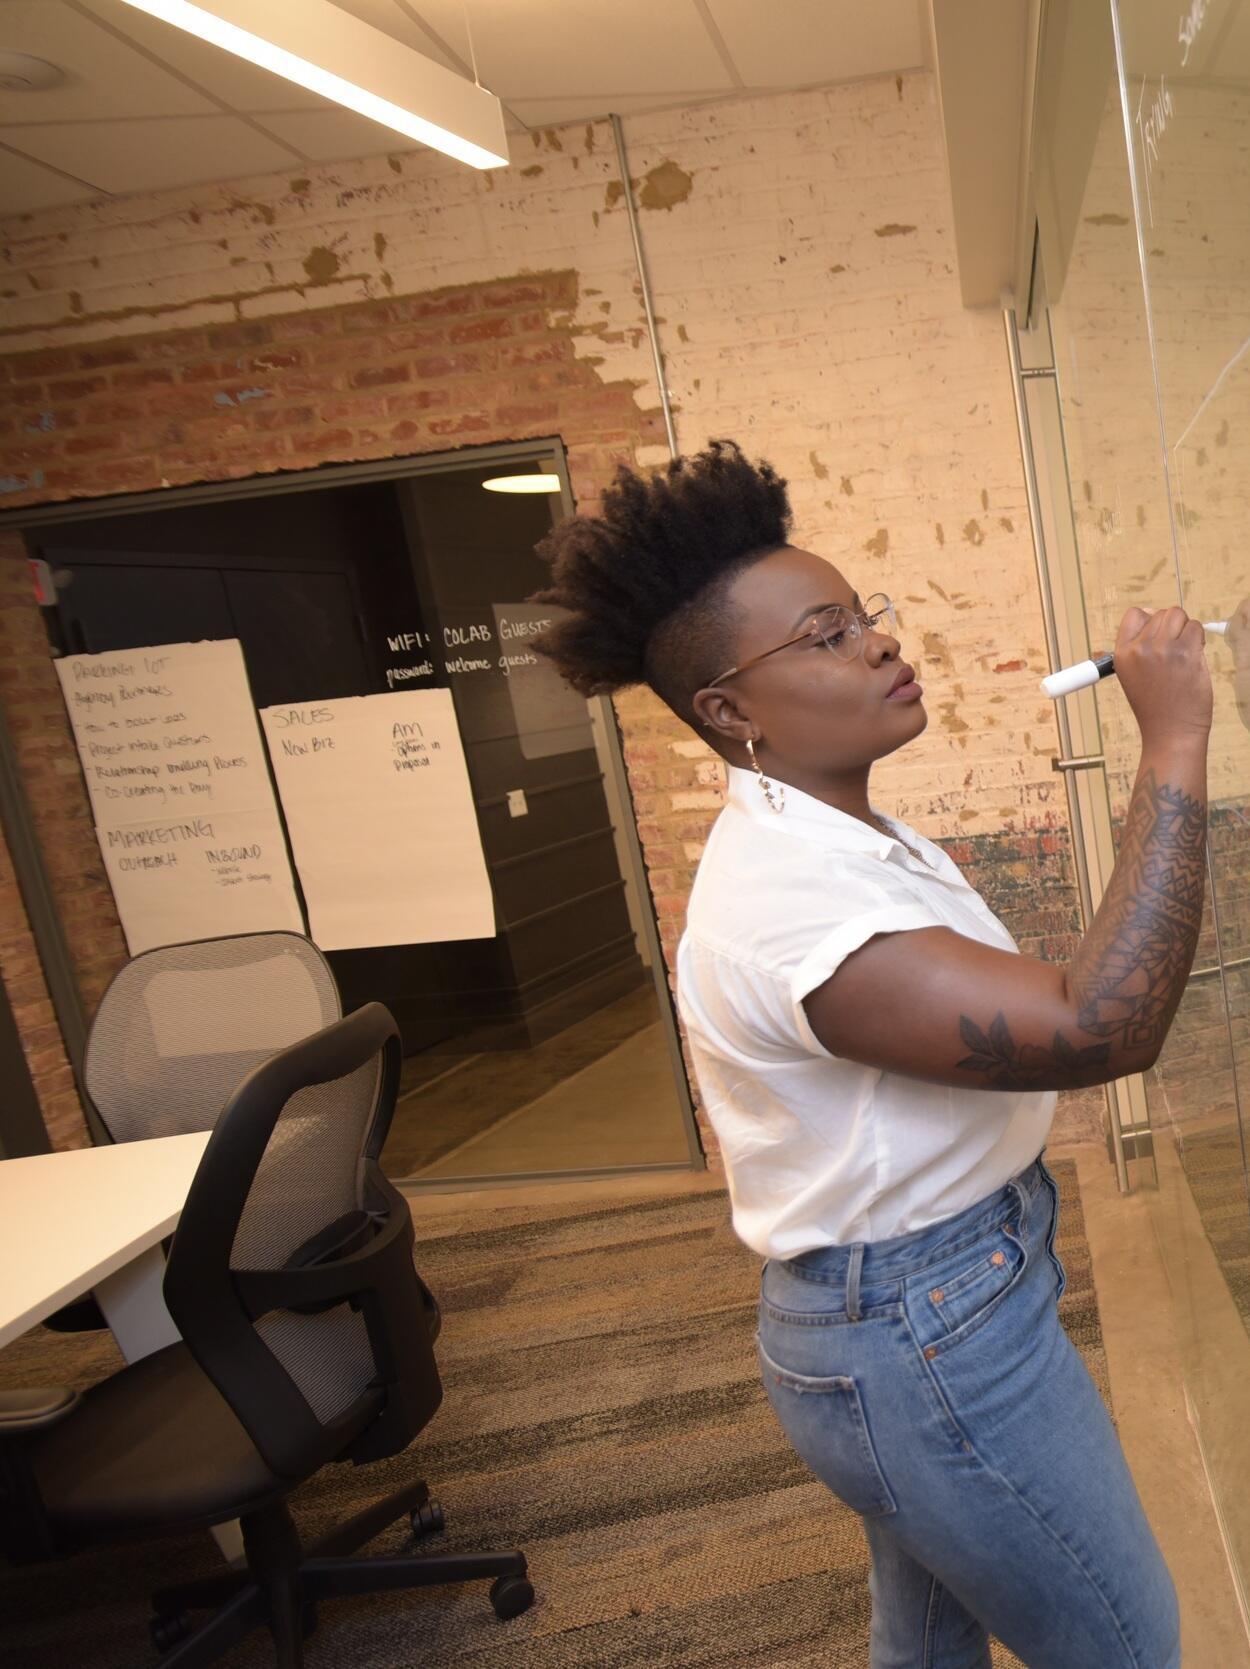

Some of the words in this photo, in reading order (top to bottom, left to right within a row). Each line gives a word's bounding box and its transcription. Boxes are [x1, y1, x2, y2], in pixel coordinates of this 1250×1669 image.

[387, 632, 431, 653] WIFI:
[443, 624, 492, 648] COLAB
[272, 707, 335, 729] SALES
[392, 722, 424, 739] AM
[108, 821, 215, 848] MARKETING
[205, 845, 262, 864] INBOUND
